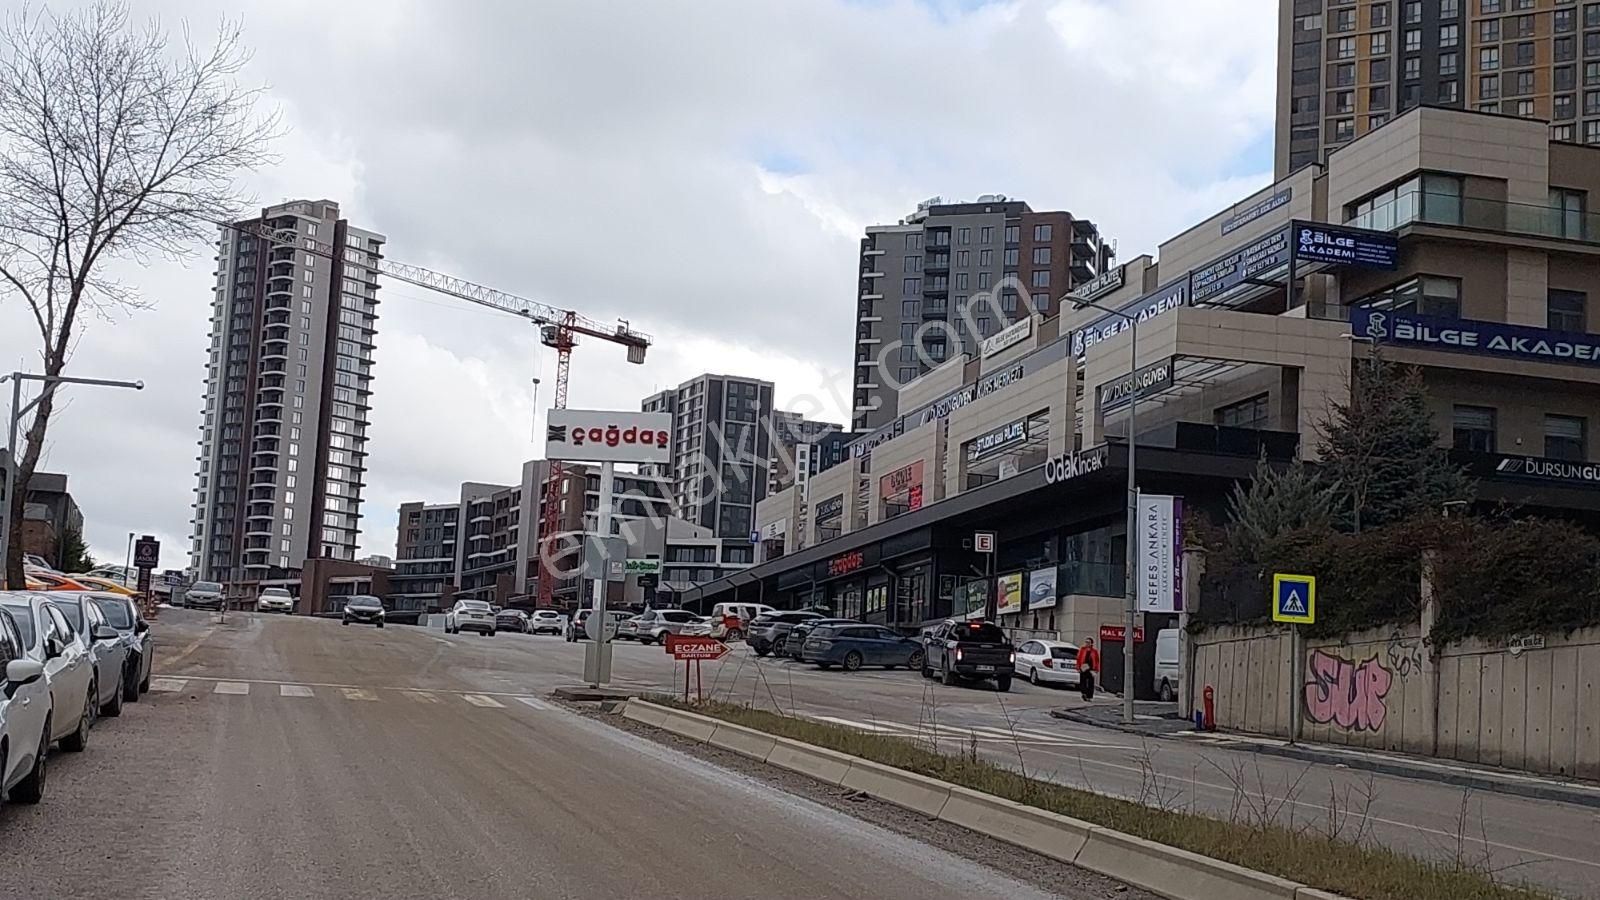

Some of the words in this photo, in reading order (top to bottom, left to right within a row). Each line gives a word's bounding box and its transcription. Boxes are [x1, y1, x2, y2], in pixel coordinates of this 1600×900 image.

[1314, 232, 1355, 248] BİLGE
[1395, 322, 1479, 347] BİLGE
[571, 425, 669, 449] çağdaş
[1148, 504, 1158, 559] ANKARA
[1148, 565, 1158, 606] NEFES
[1101, 629, 1117, 637] MAL
[1118, 630, 1142, 639] KAUL
[674, 644, 722, 652] ECZANE
